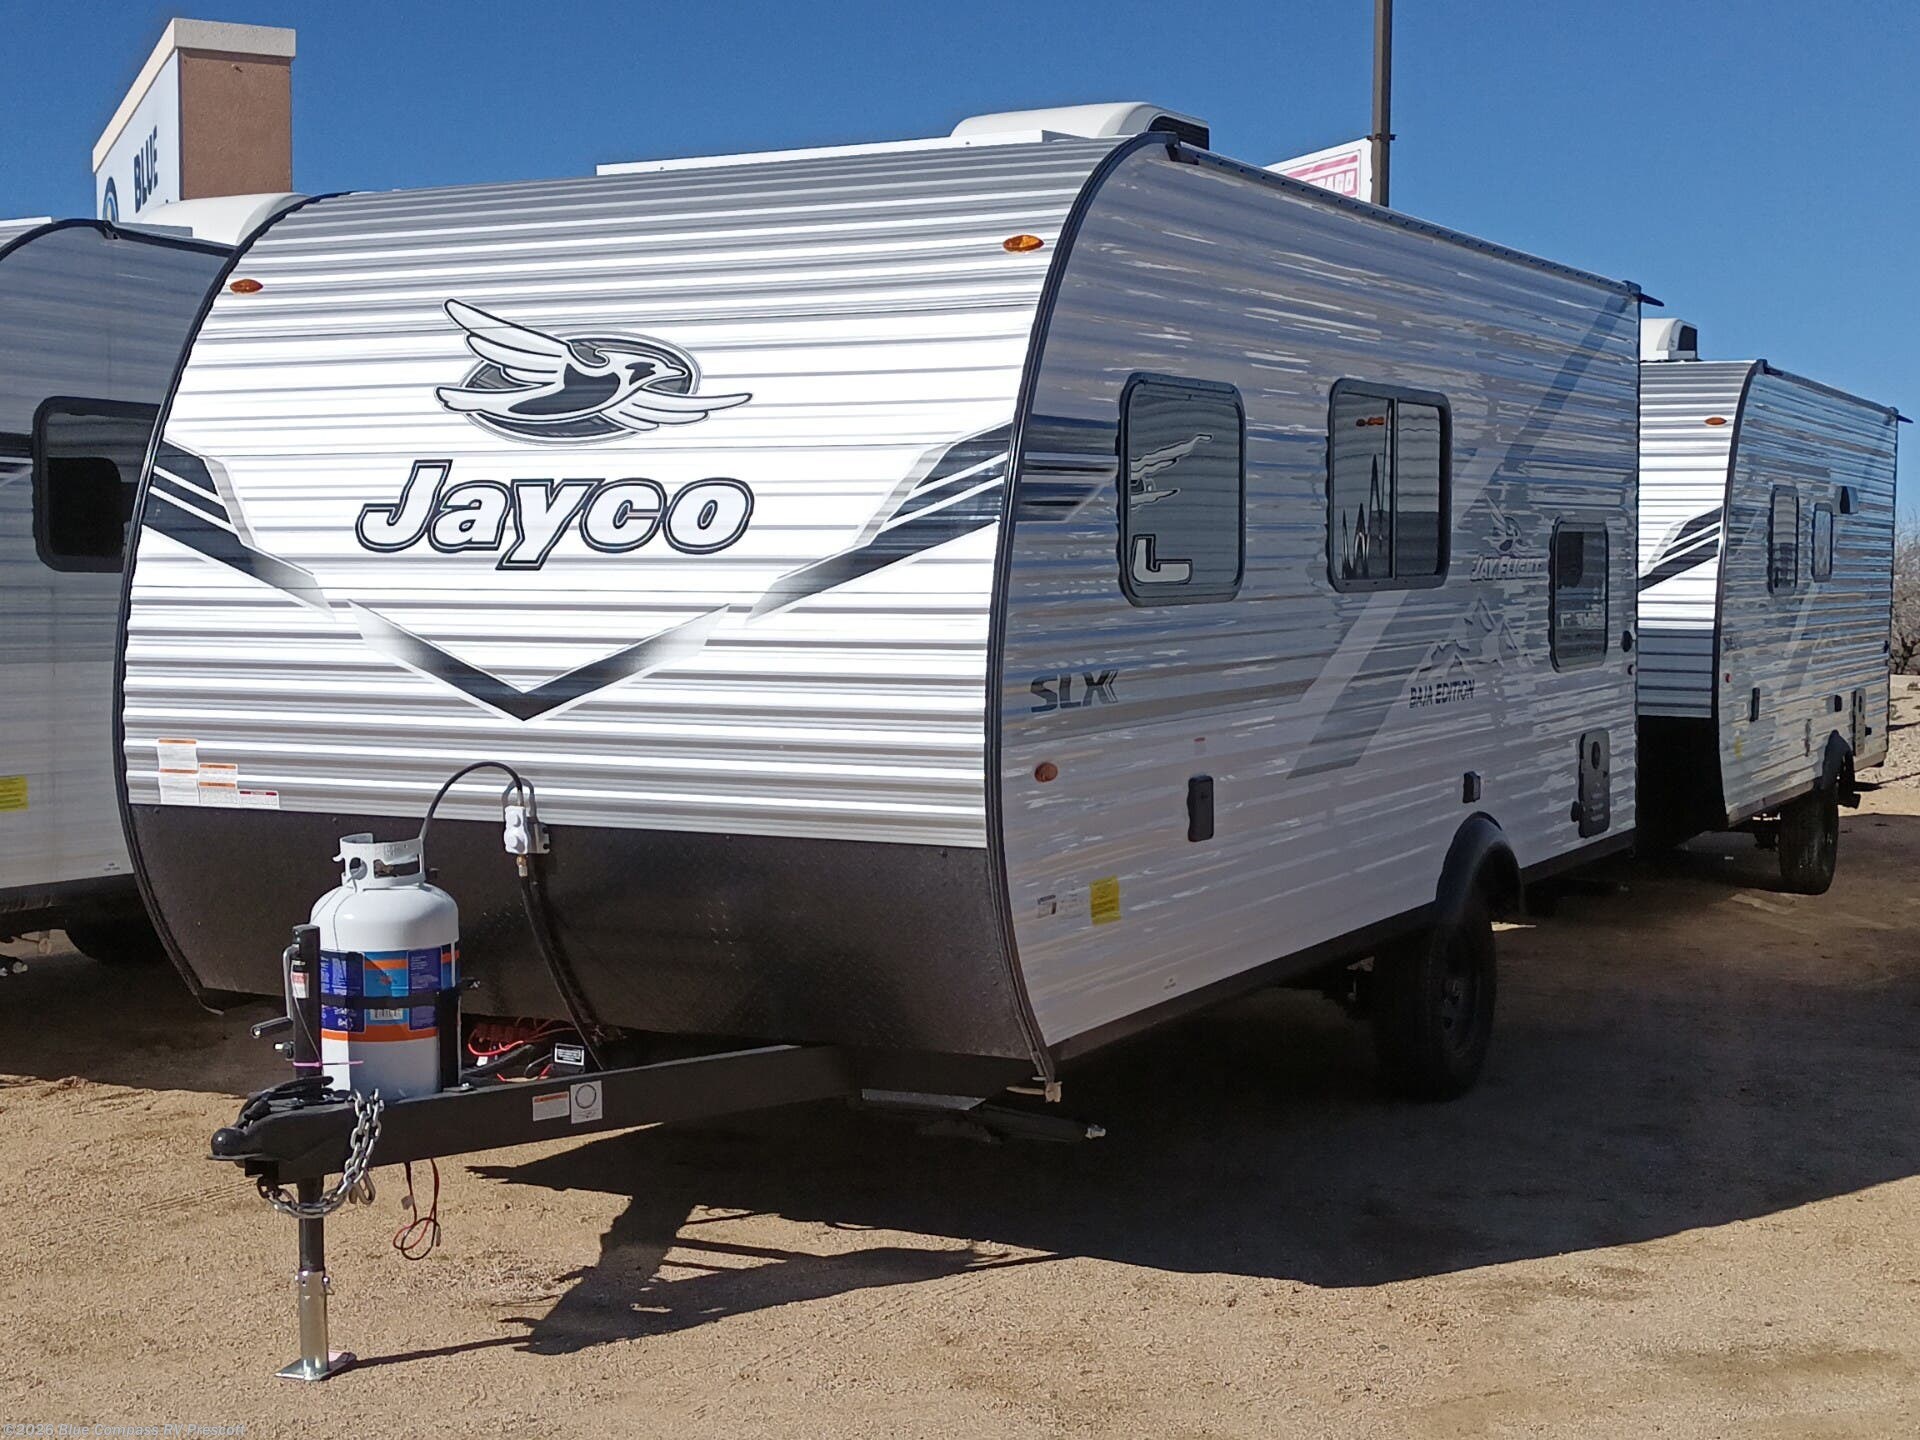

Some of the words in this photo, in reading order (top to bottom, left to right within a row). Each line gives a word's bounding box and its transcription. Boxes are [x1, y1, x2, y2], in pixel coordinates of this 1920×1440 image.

[133, 125, 159, 214] BLUE
[354, 458, 756, 571] Jayco
[1030, 669, 1119, 713] SLX
[1435, 679, 1475, 704] EDITION
